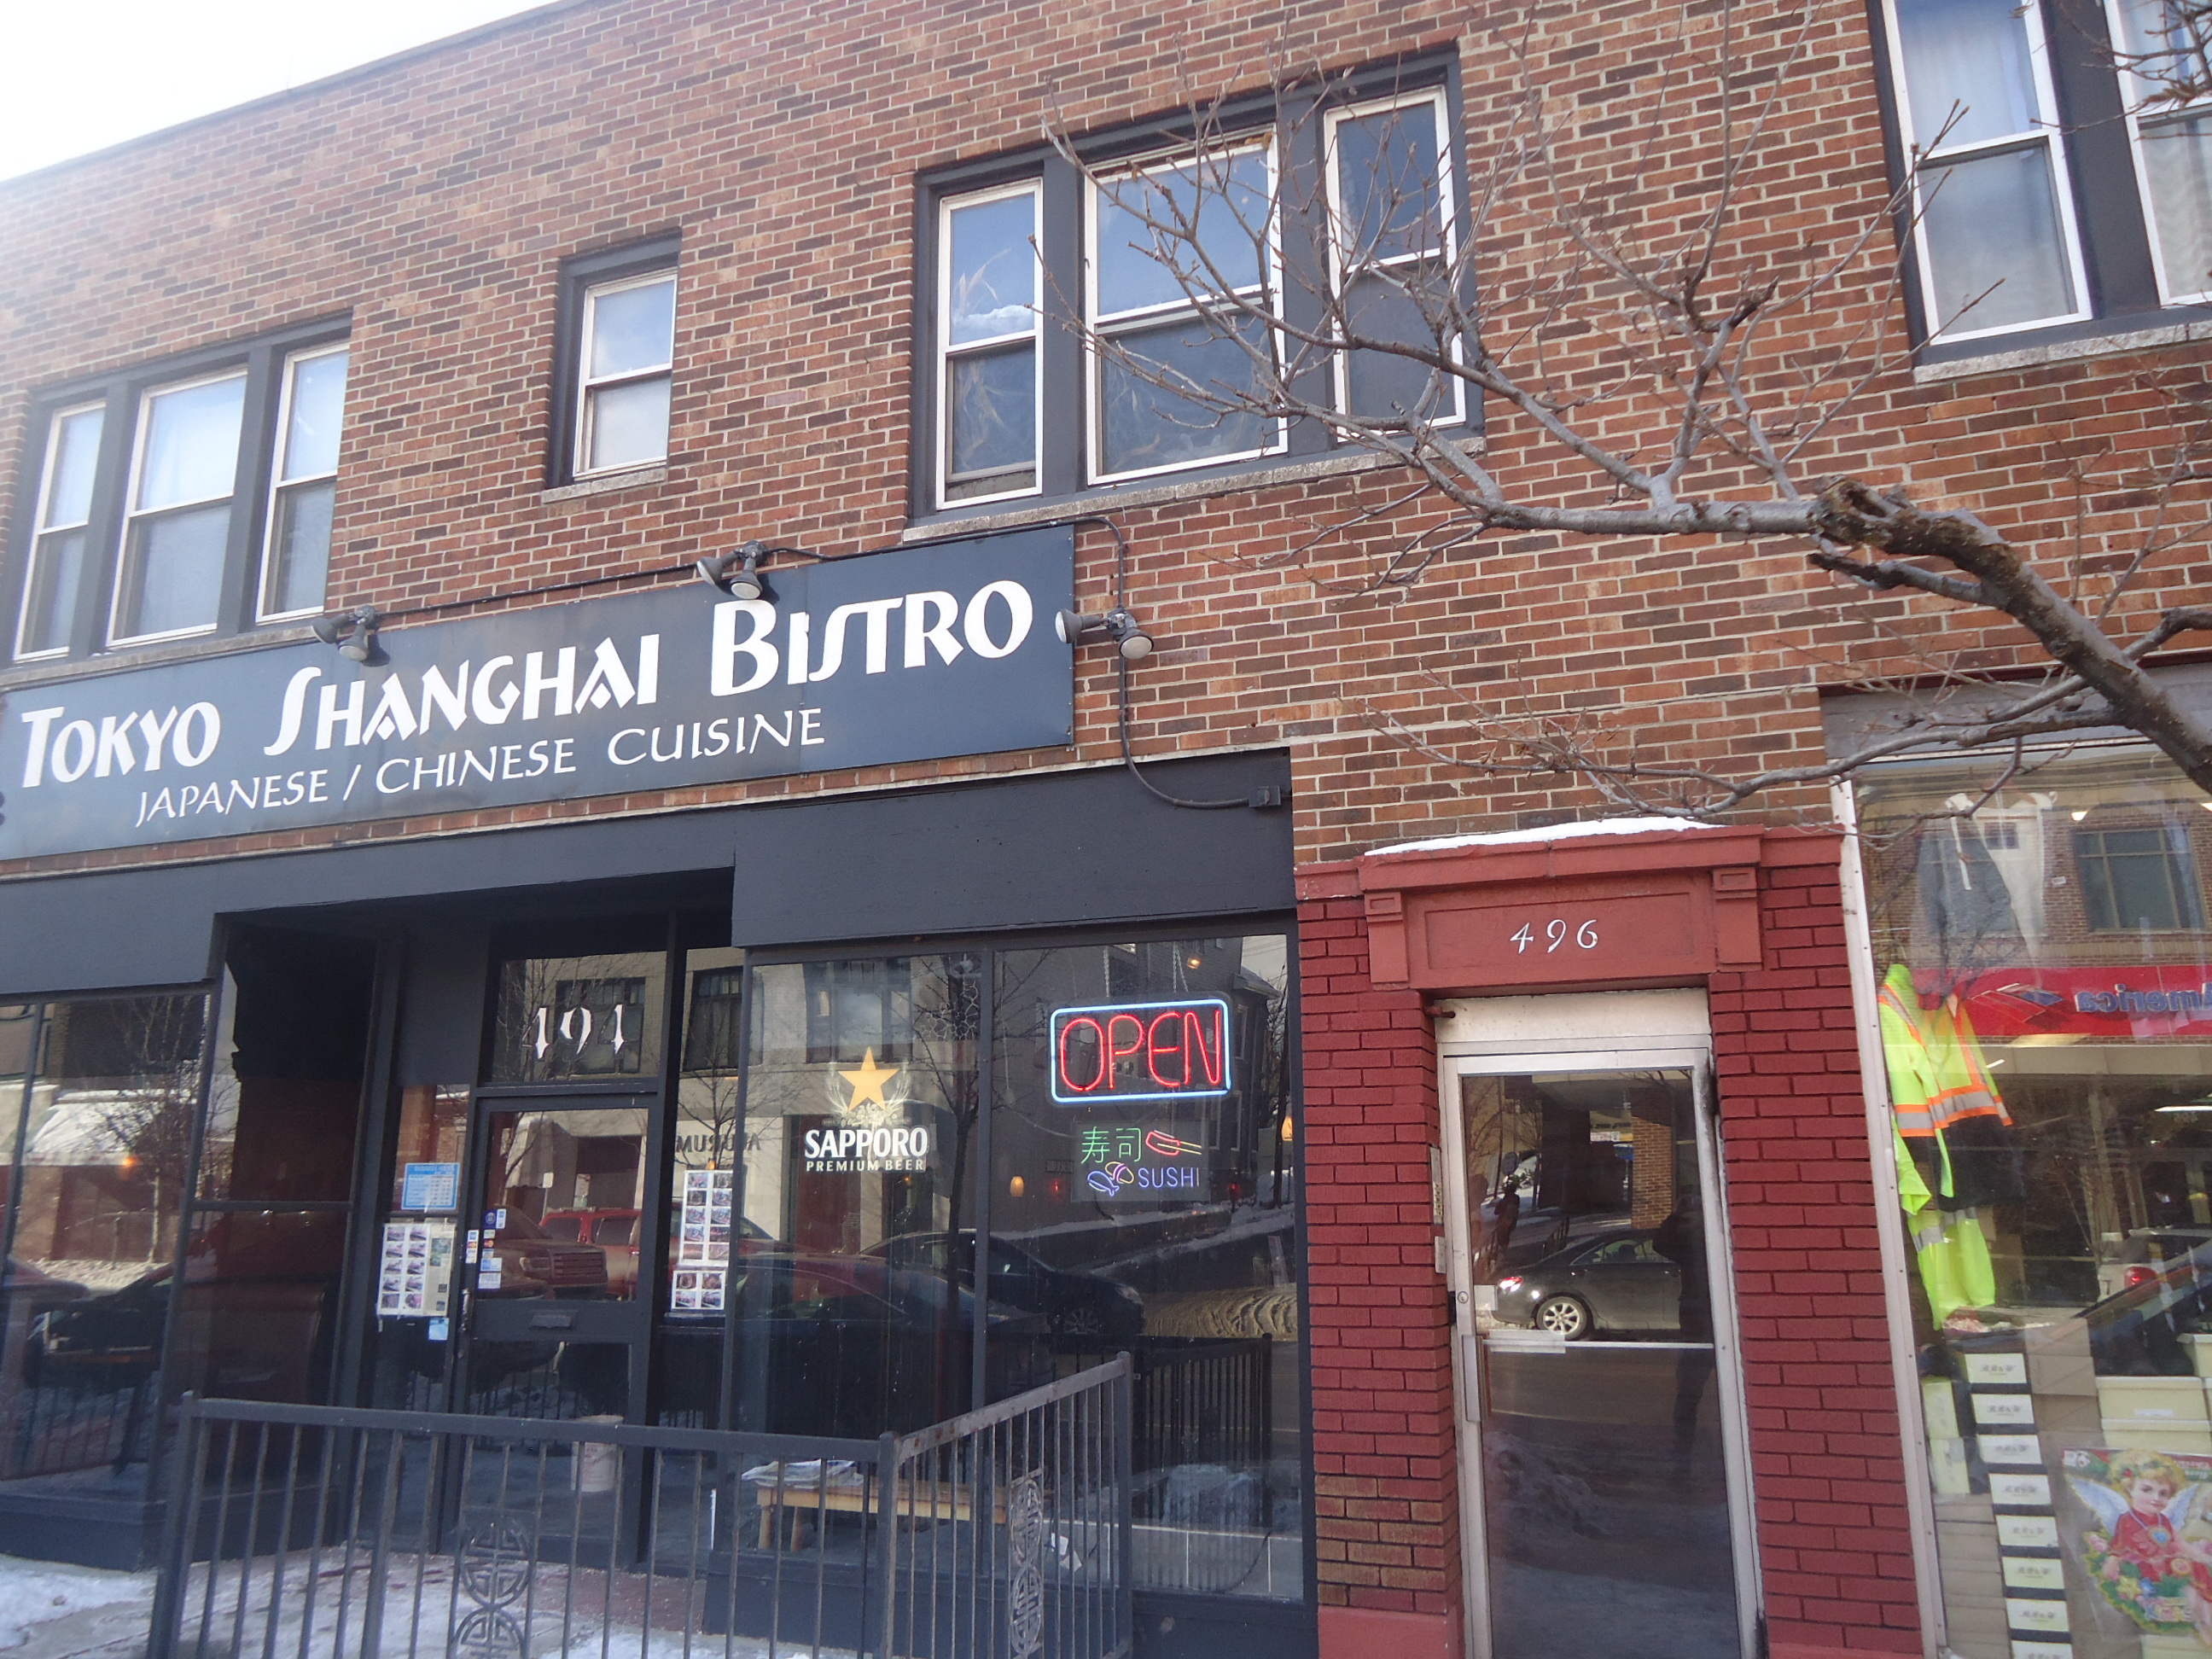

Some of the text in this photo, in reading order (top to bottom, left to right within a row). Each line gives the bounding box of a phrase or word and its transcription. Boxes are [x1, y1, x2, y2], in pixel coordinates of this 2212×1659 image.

[20, 580, 1033, 789] TOKYO SHANGHAI BISTRO
[135, 766, 329, 828] JAPANESE
[375, 737, 577, 794] CHINESE
[608, 707, 825, 765] CUISINE
[1510, 919, 1599, 954] 496
[1059, 1010, 1222, 1091] OPEN
[804, 1126, 928, 1159] SAPPORO
[1081, 1126, 1142, 1164] 寿司
[806, 1158, 926, 1173] PREMIUM BEER
[1137, 1166, 1200, 1189] SUSHI
